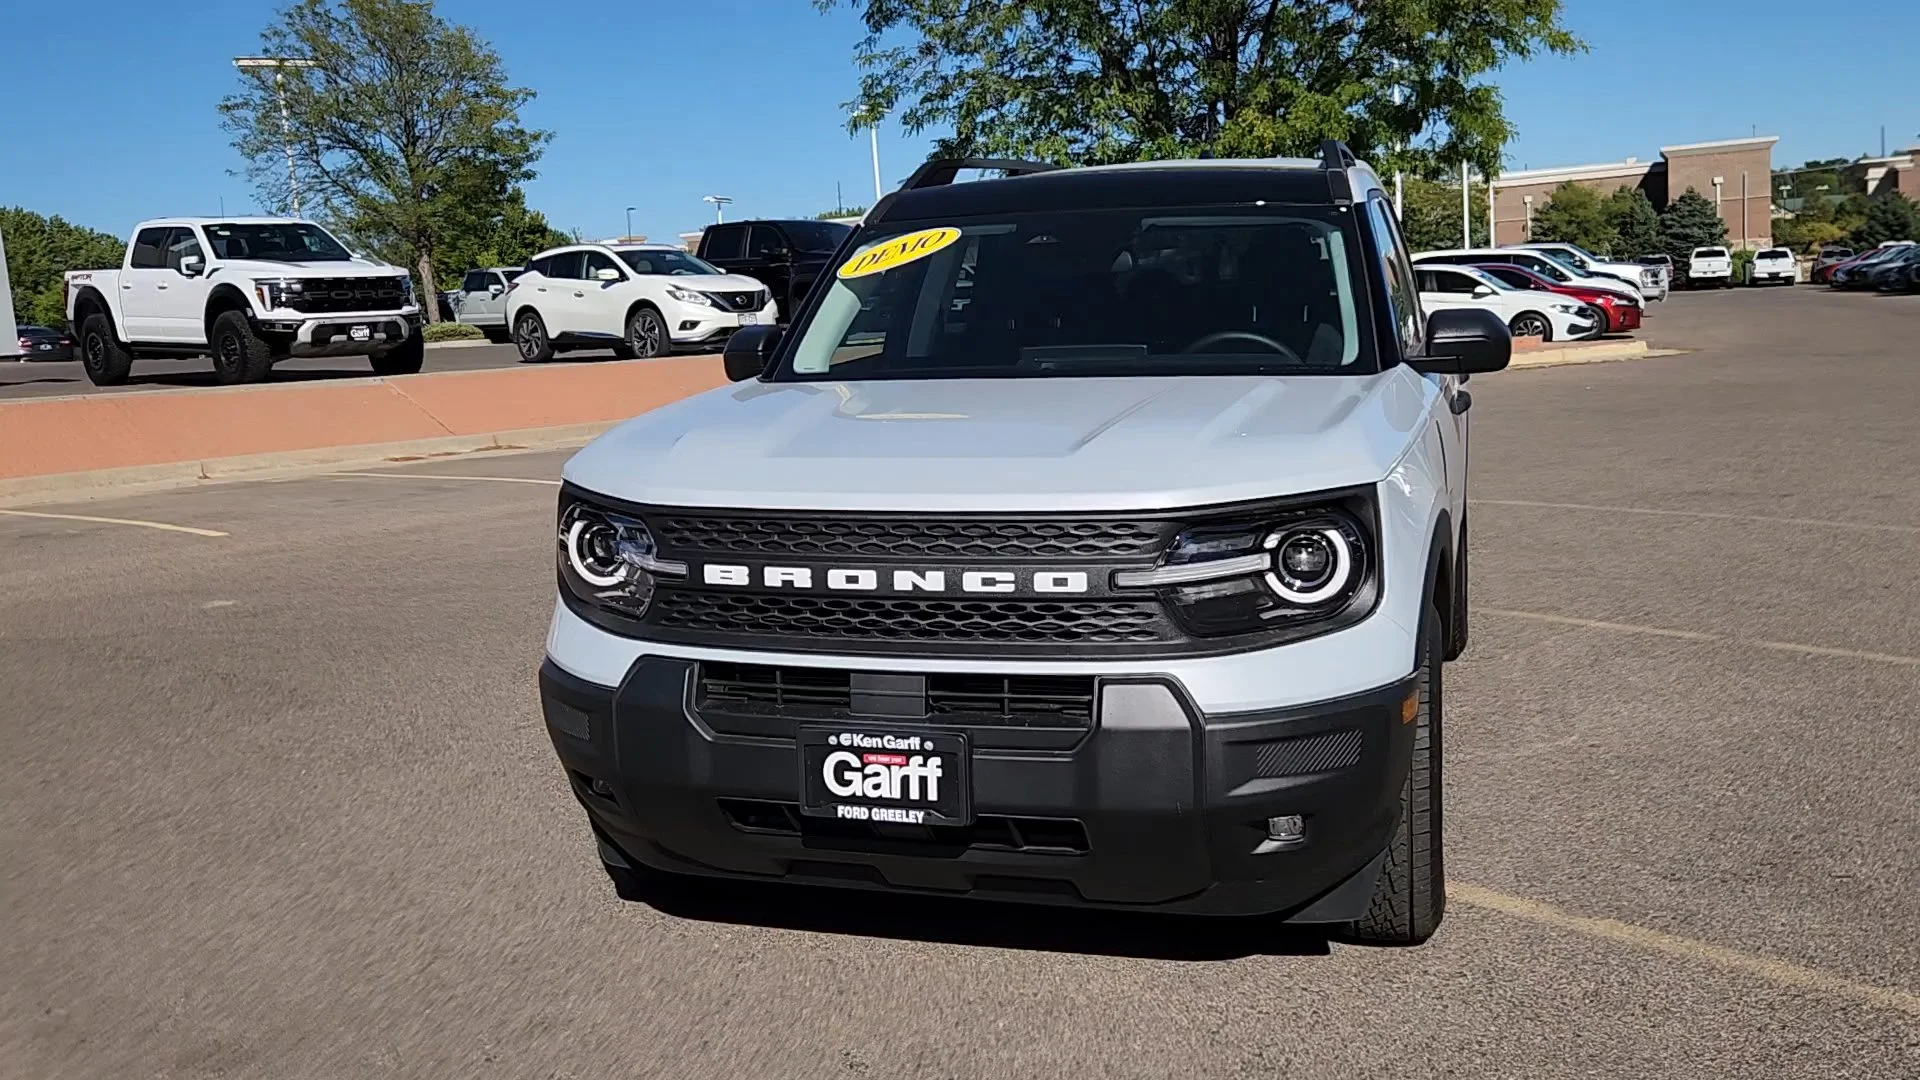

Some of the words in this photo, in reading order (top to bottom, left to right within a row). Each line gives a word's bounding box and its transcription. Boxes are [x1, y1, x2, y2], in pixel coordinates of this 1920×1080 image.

[852, 232, 946, 272] DEMO
[304, 289, 397, 301] FORD
[703, 564, 1088, 593] BRONCO
[823, 751, 942, 801] Garff
[837, 805, 869, 820] FORD
[871, 808, 925, 824] GREELEY
